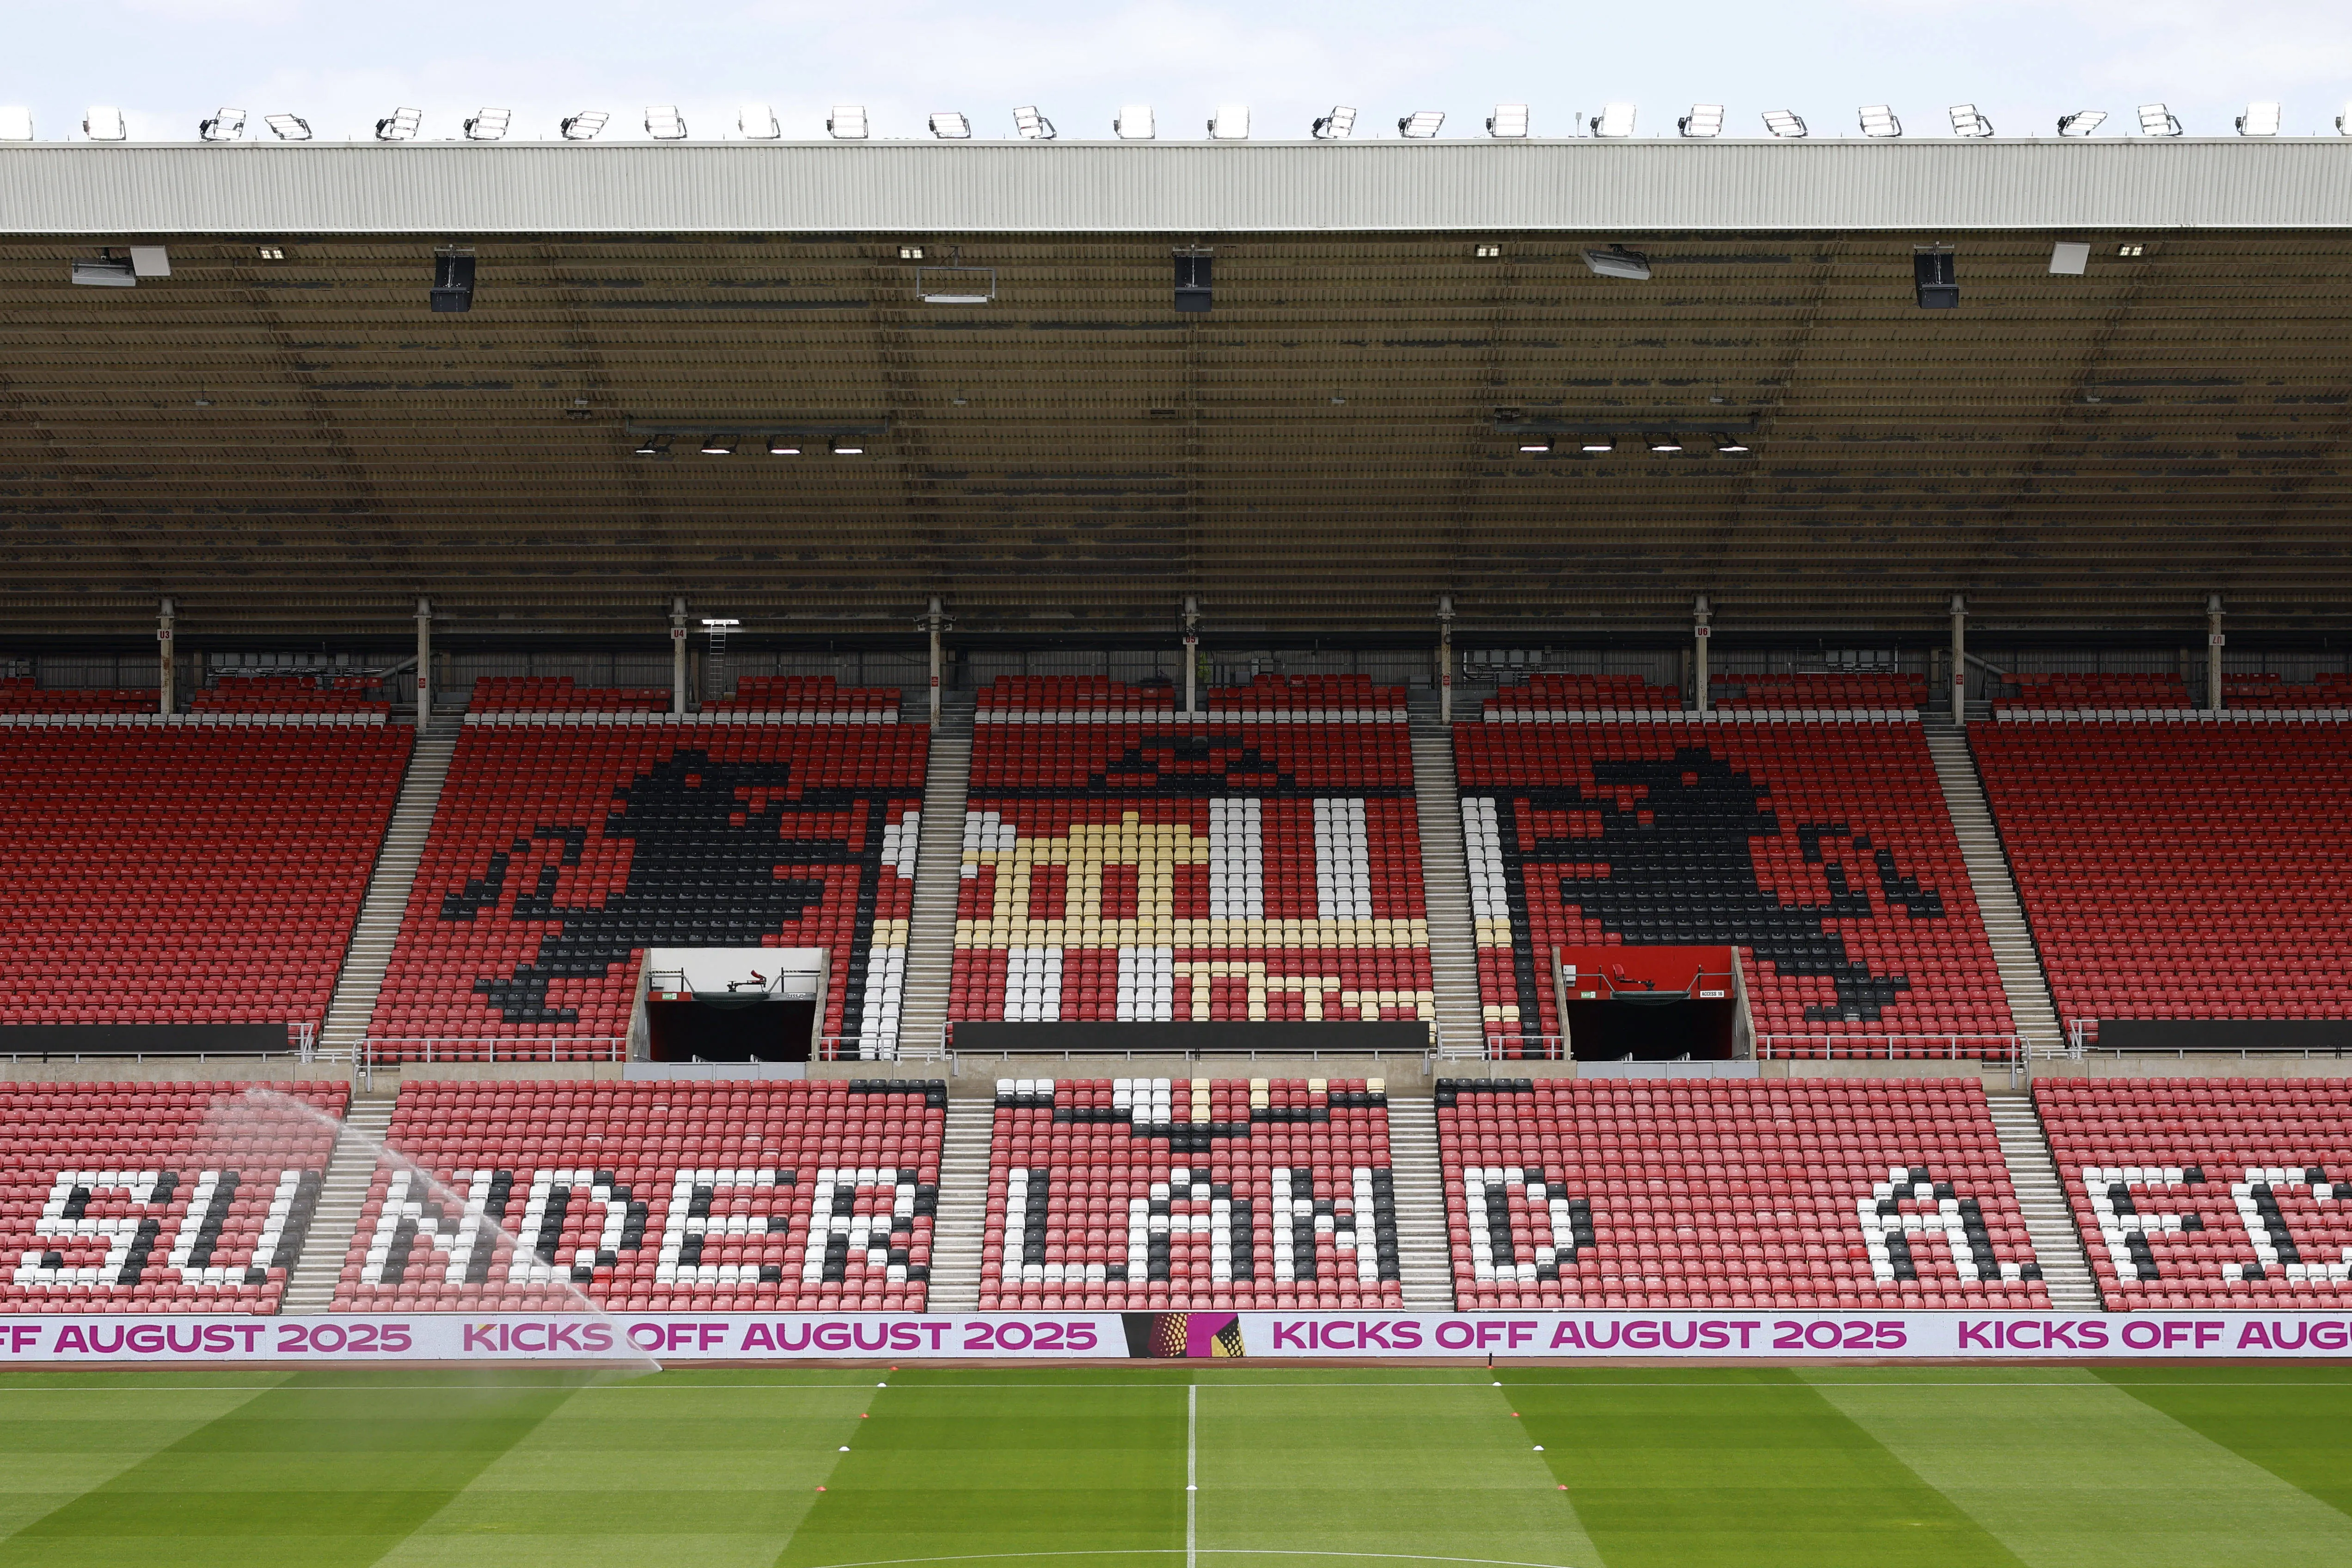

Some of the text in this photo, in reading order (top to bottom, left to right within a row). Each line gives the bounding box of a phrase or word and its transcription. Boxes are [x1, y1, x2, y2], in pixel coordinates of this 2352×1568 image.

[674, 629, 684, 637] U4
[12, 1166, 1595, 1289] SUNDERLAND
[54, 1324, 265, 1353] AUGUST
[277, 1323, 411, 1353] 2025
[465, 1322, 1097, 1351] KICKS OFF AUGUST 2025
[1274, 1320, 1907, 1349] KICKS OFF AUGUST 2025
[1959, 1321, 2109, 1349] KICKS
[2122, 1321, 2225, 1349] OFF
